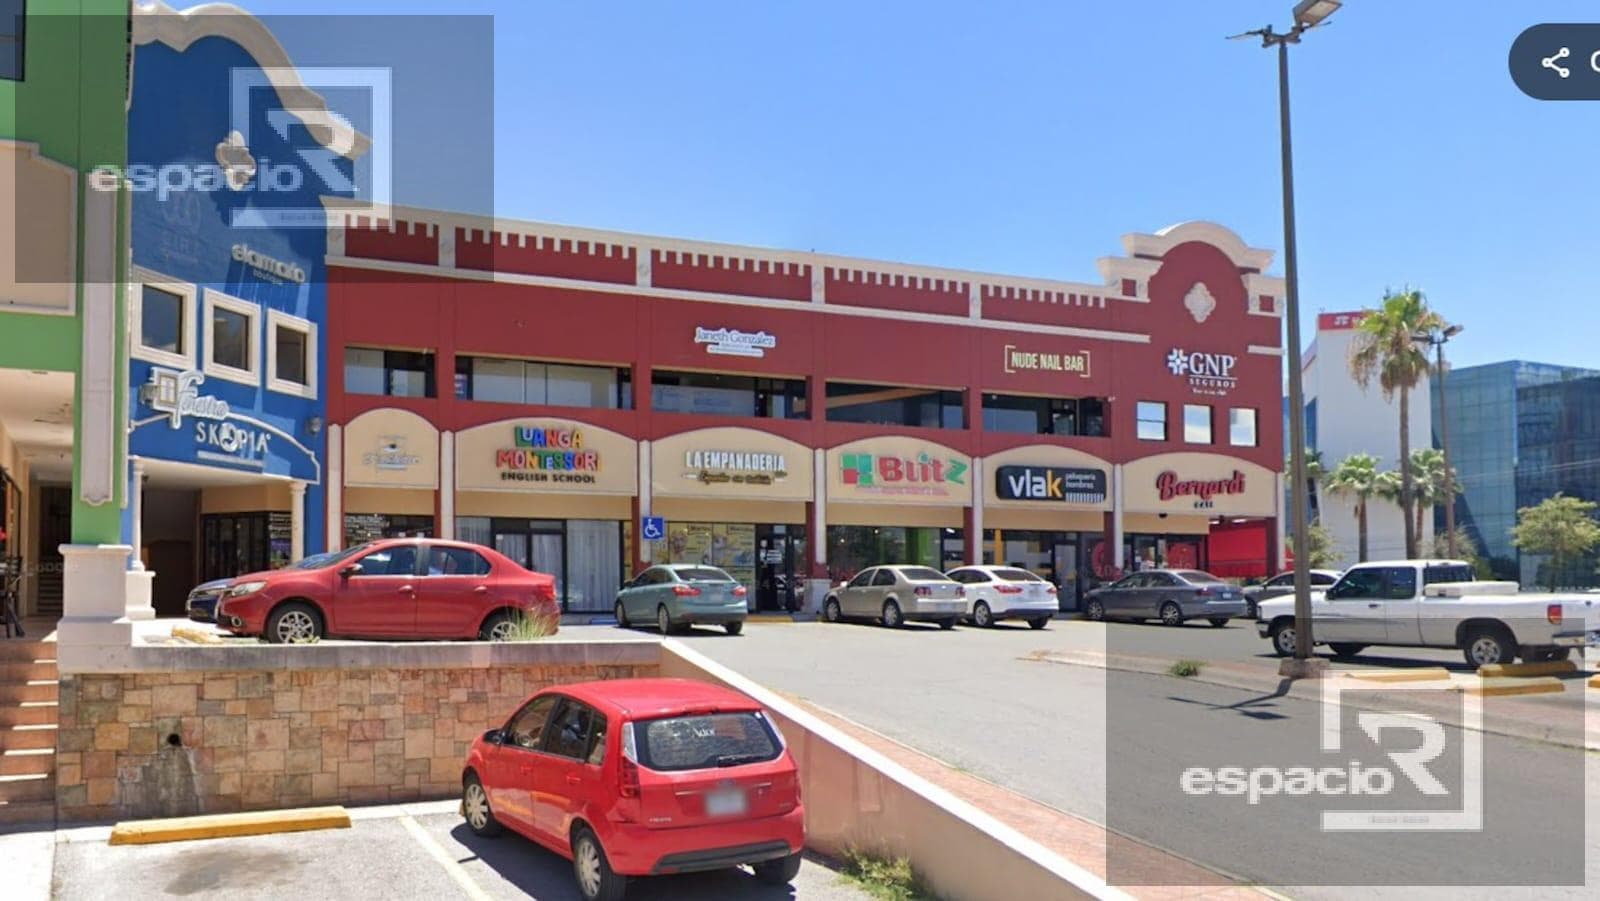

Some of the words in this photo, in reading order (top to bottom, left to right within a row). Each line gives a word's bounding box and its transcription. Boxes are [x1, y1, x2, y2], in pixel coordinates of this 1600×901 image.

[1011, 351, 1039, 369] NUDE
[1040, 353, 1063, 371] NAIL
[1064, 355, 1084, 371] BAR
[1188, 351, 1235, 376] GNP
[1188, 378, 1236, 389] SEGUROS
[514, 426, 584, 448] LUANGA
[495, 448, 603, 473] MONTESSORI
[685, 450, 702, 469] LA
[703, 451, 785, 472] EMPANADERIA
[500, 471, 548, 483] ENGLISH
[552, 473, 597, 484] SCHOOL
[1008, 469, 1063, 498] vlak
[1156, 469, 1246, 502] Bernardi
